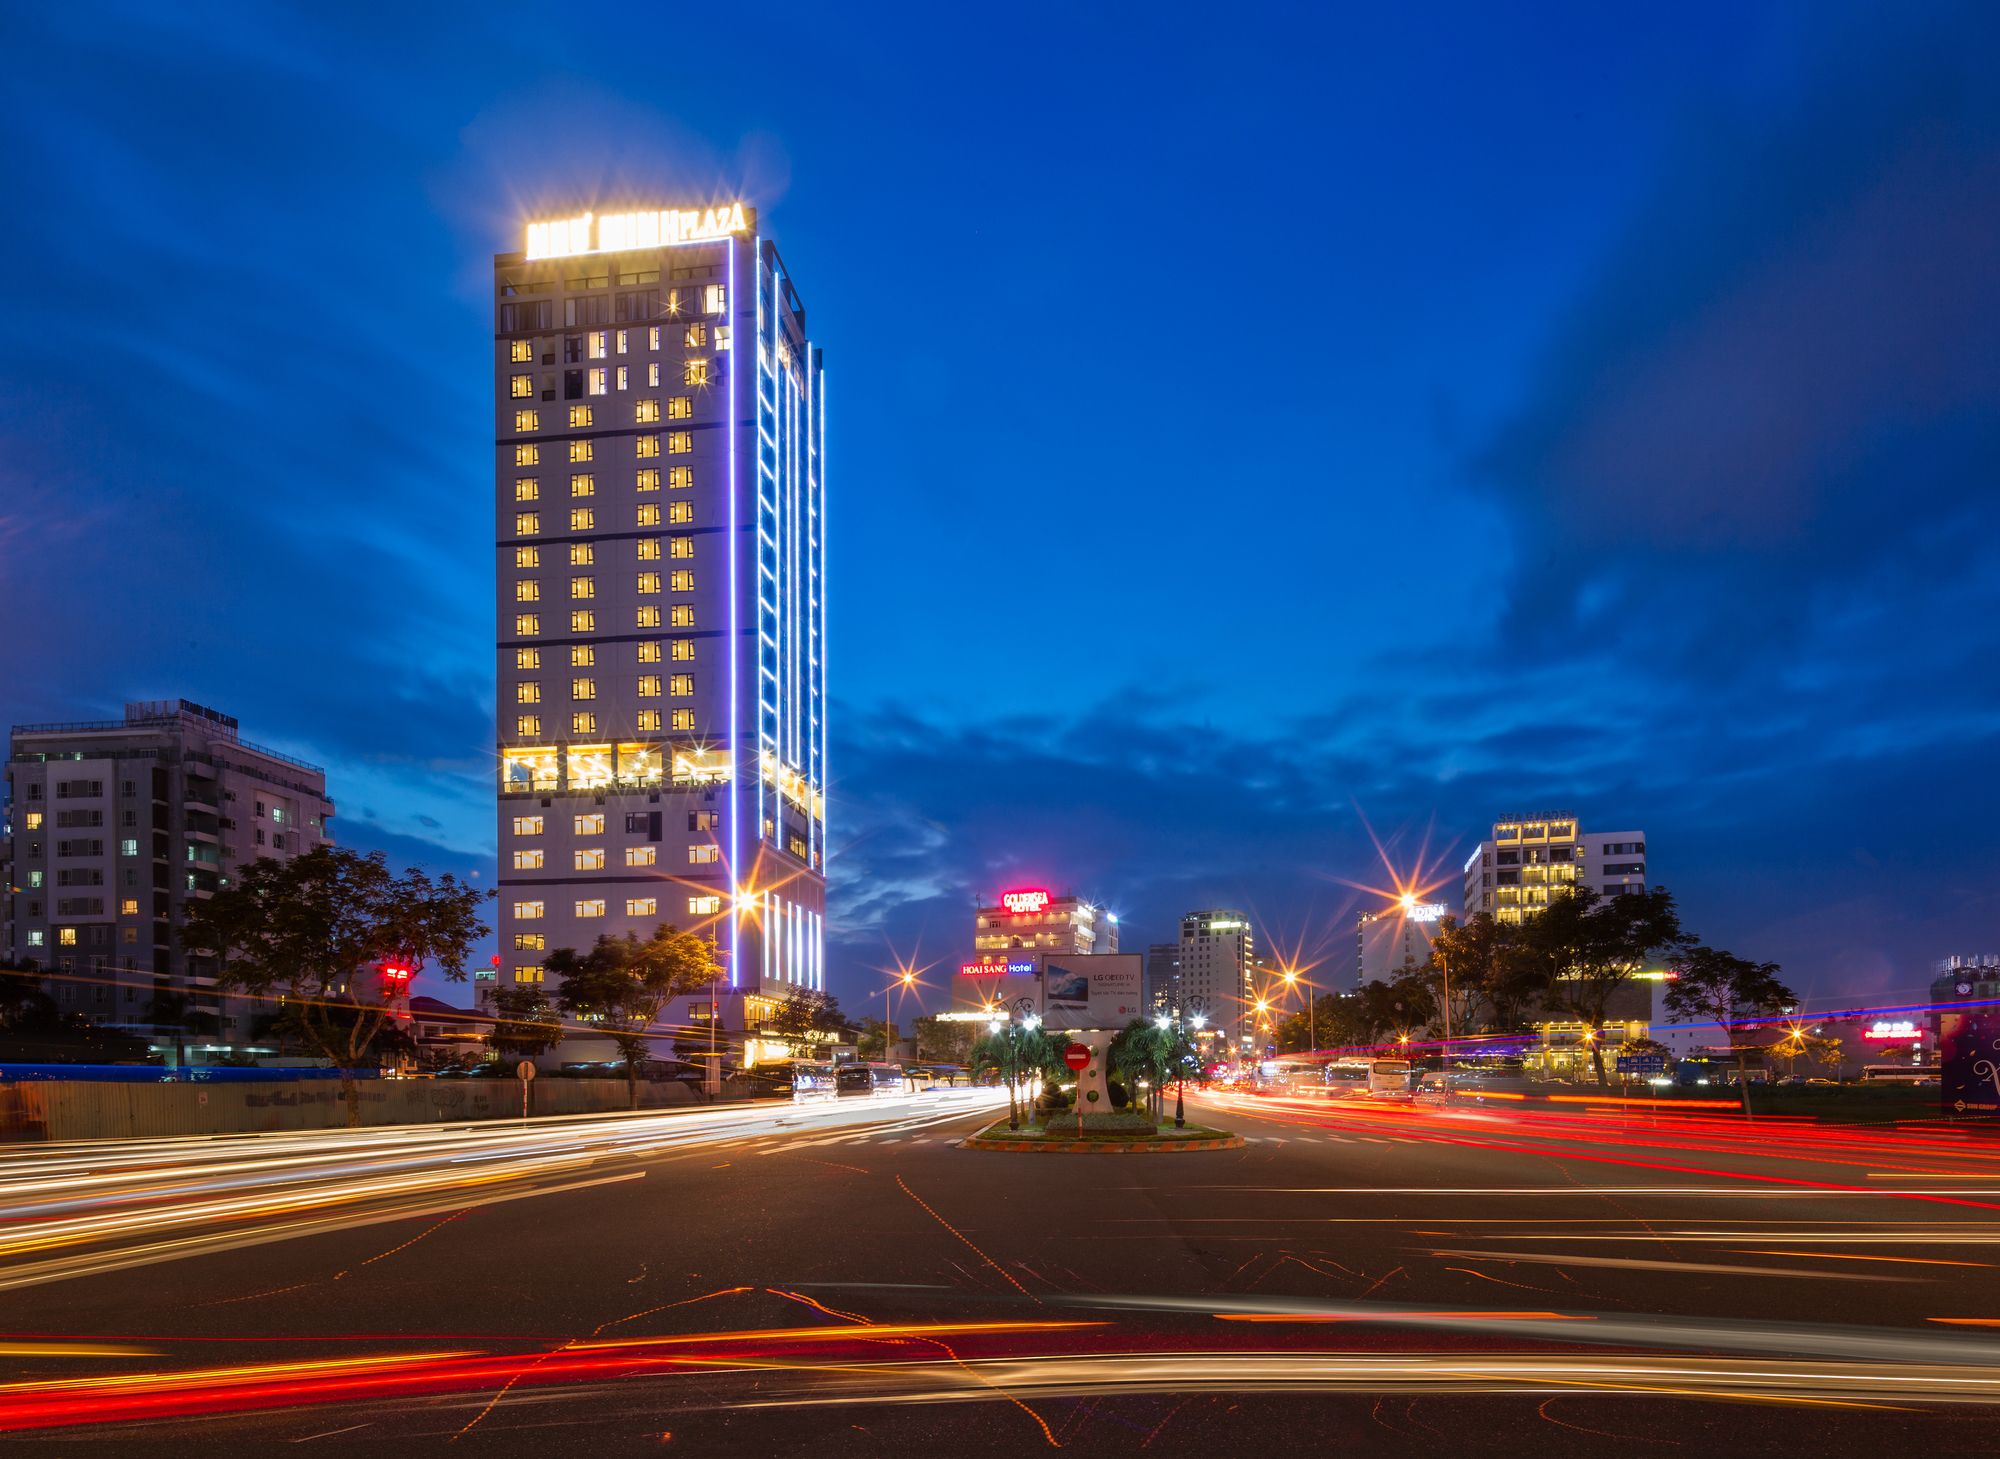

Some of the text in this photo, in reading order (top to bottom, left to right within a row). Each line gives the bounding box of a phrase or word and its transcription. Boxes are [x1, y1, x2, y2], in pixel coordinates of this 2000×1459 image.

[680, 203, 746, 241] PLAZA
[983, 964, 1007, 974] SANG
[1008, 963, 1032, 973] Hotel
[1125, 973, 1136, 981] TV
